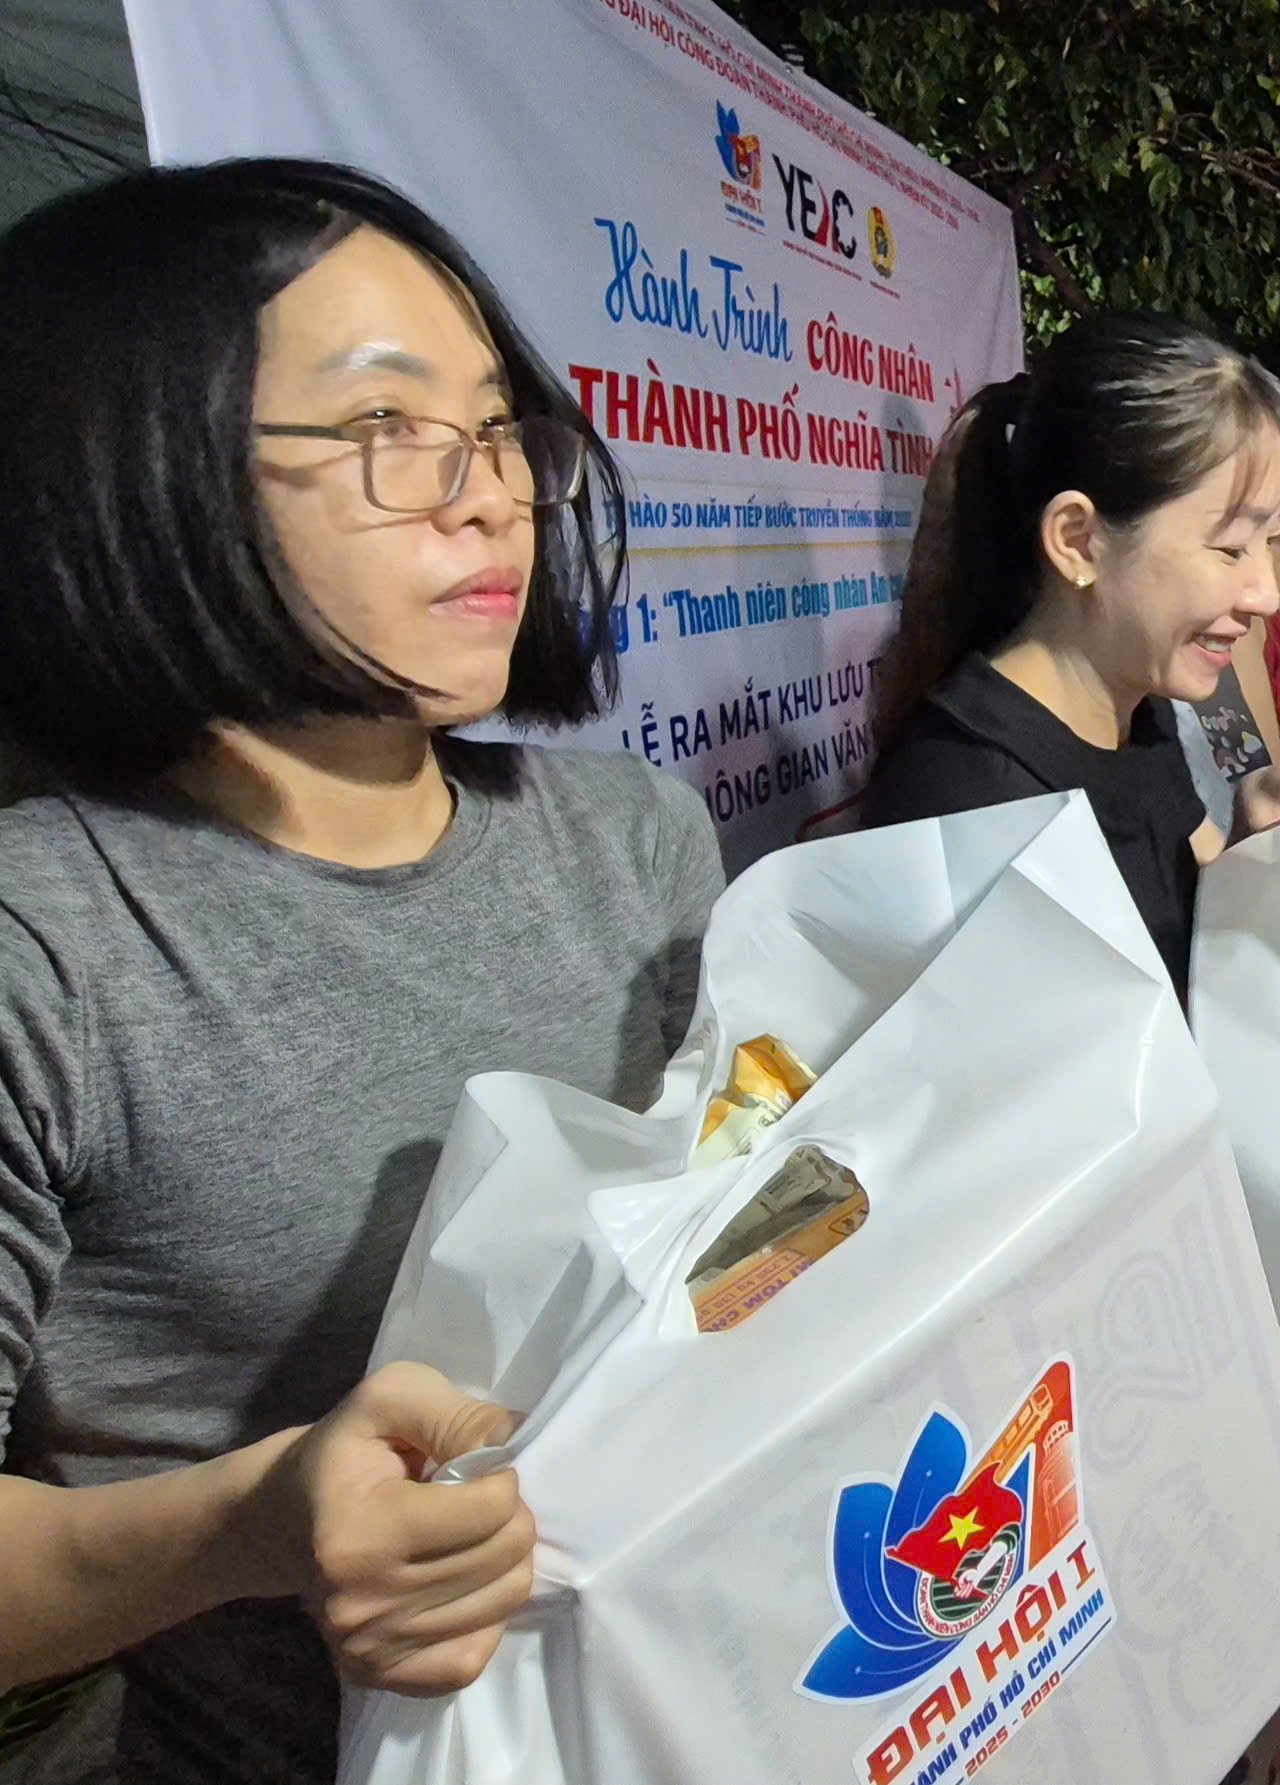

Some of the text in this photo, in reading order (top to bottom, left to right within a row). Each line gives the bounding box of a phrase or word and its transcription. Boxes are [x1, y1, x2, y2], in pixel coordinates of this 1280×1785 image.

[619, 1, 646, 30] ĐẠI
[650, 12, 676, 48] HỘI
[676, 31, 714, 71] CÔNG
[594, 218, 793, 362] Hành Trình
[807, 311, 935, 403] CÔNG NHÂN
[568, 358, 935, 477] THÀNH PHỐ NGHĨA TÌNH
[628, 493, 668, 528] HÀO
[672, 503, 692, 528] 50
[696, 495, 731, 528] NĂM
[734, 493, 762, 528] TIẾP
[637, 593, 659, 642] 1:
[745, 581, 786, 625] niên
[791, 578, 831, 618] công
[833, 574, 868, 610] nhân
[669, 708, 713, 763] RA
[719, 676, 772, 746] MẮT
[777, 675, 823, 725] KHU
[827, 661, 864, 707] LƯU
[777, 740, 829, 795] GIAN
[831, 719, 869, 769] VĂN
[866, 1540, 1096, 1785] ĐẠI HỘI I
[959, 1696, 998, 1750] PHỐ
[999, 1669, 1026, 1709] HỒ
[1027, 1635, 1057, 1680] CHÍ
[1058, 1588, 1105, 1647] MINH
[964, 1725, 1009, 1777] 2025
[1020, 1670, 1061, 1719] 2030
